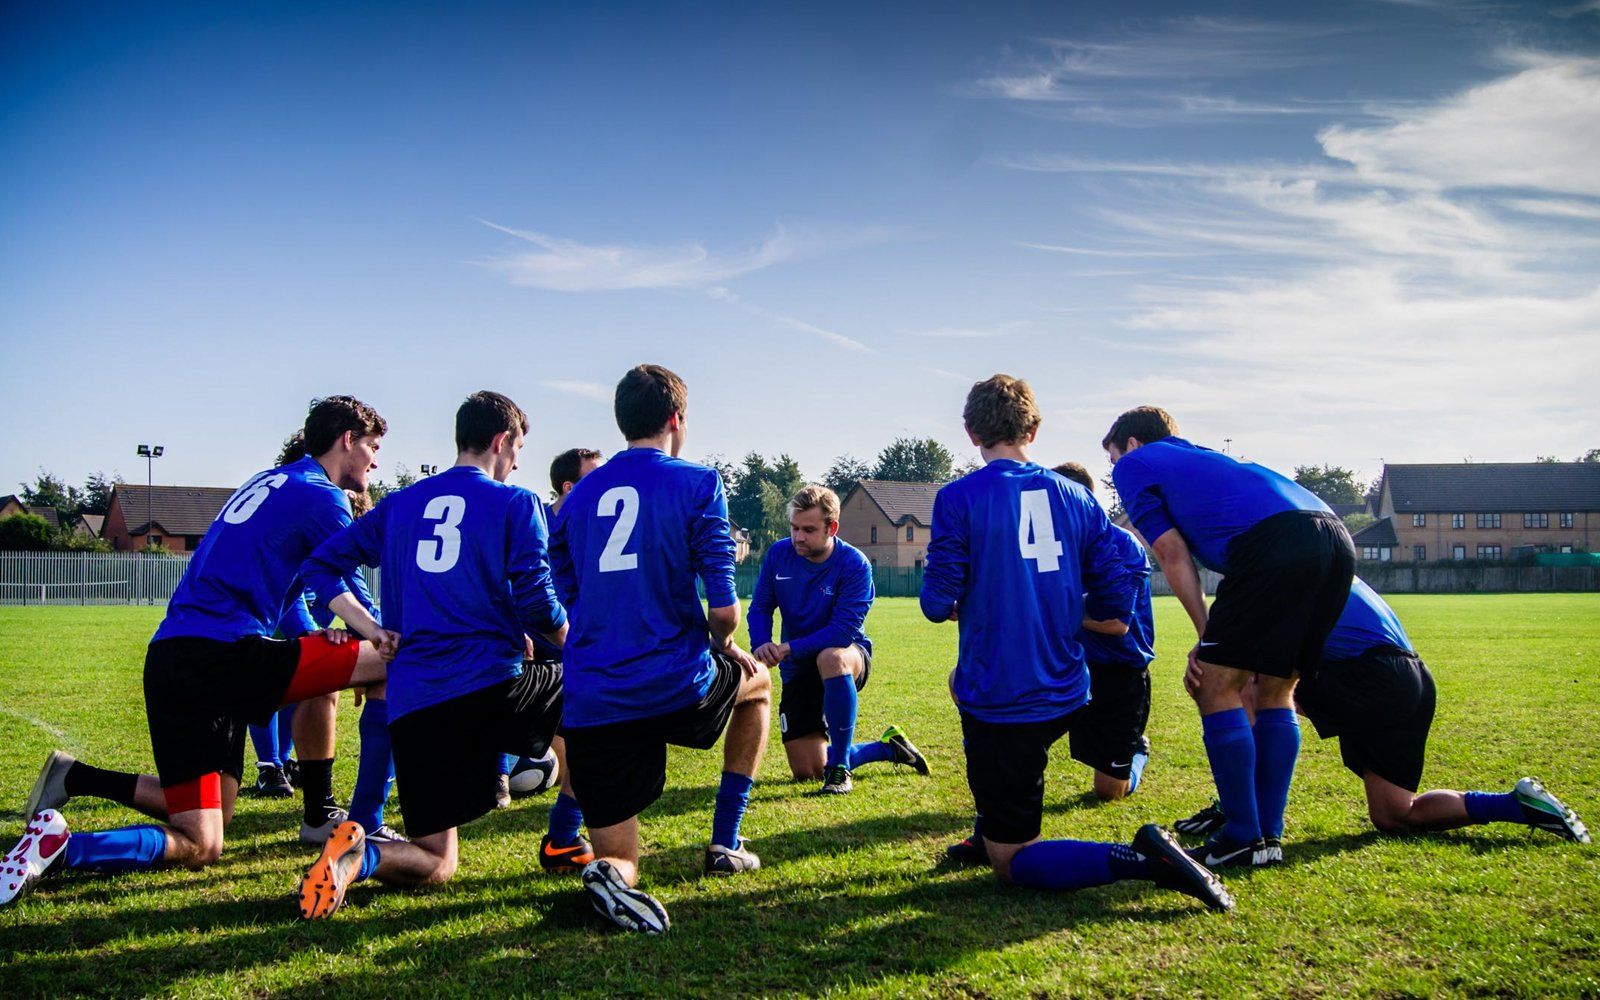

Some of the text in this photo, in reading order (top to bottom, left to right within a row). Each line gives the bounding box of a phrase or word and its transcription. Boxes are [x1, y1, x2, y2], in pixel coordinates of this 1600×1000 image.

[416, 495, 466, 573] 3
[597, 486, 640, 573] 2
[1018, 488, 1064, 573] 4
